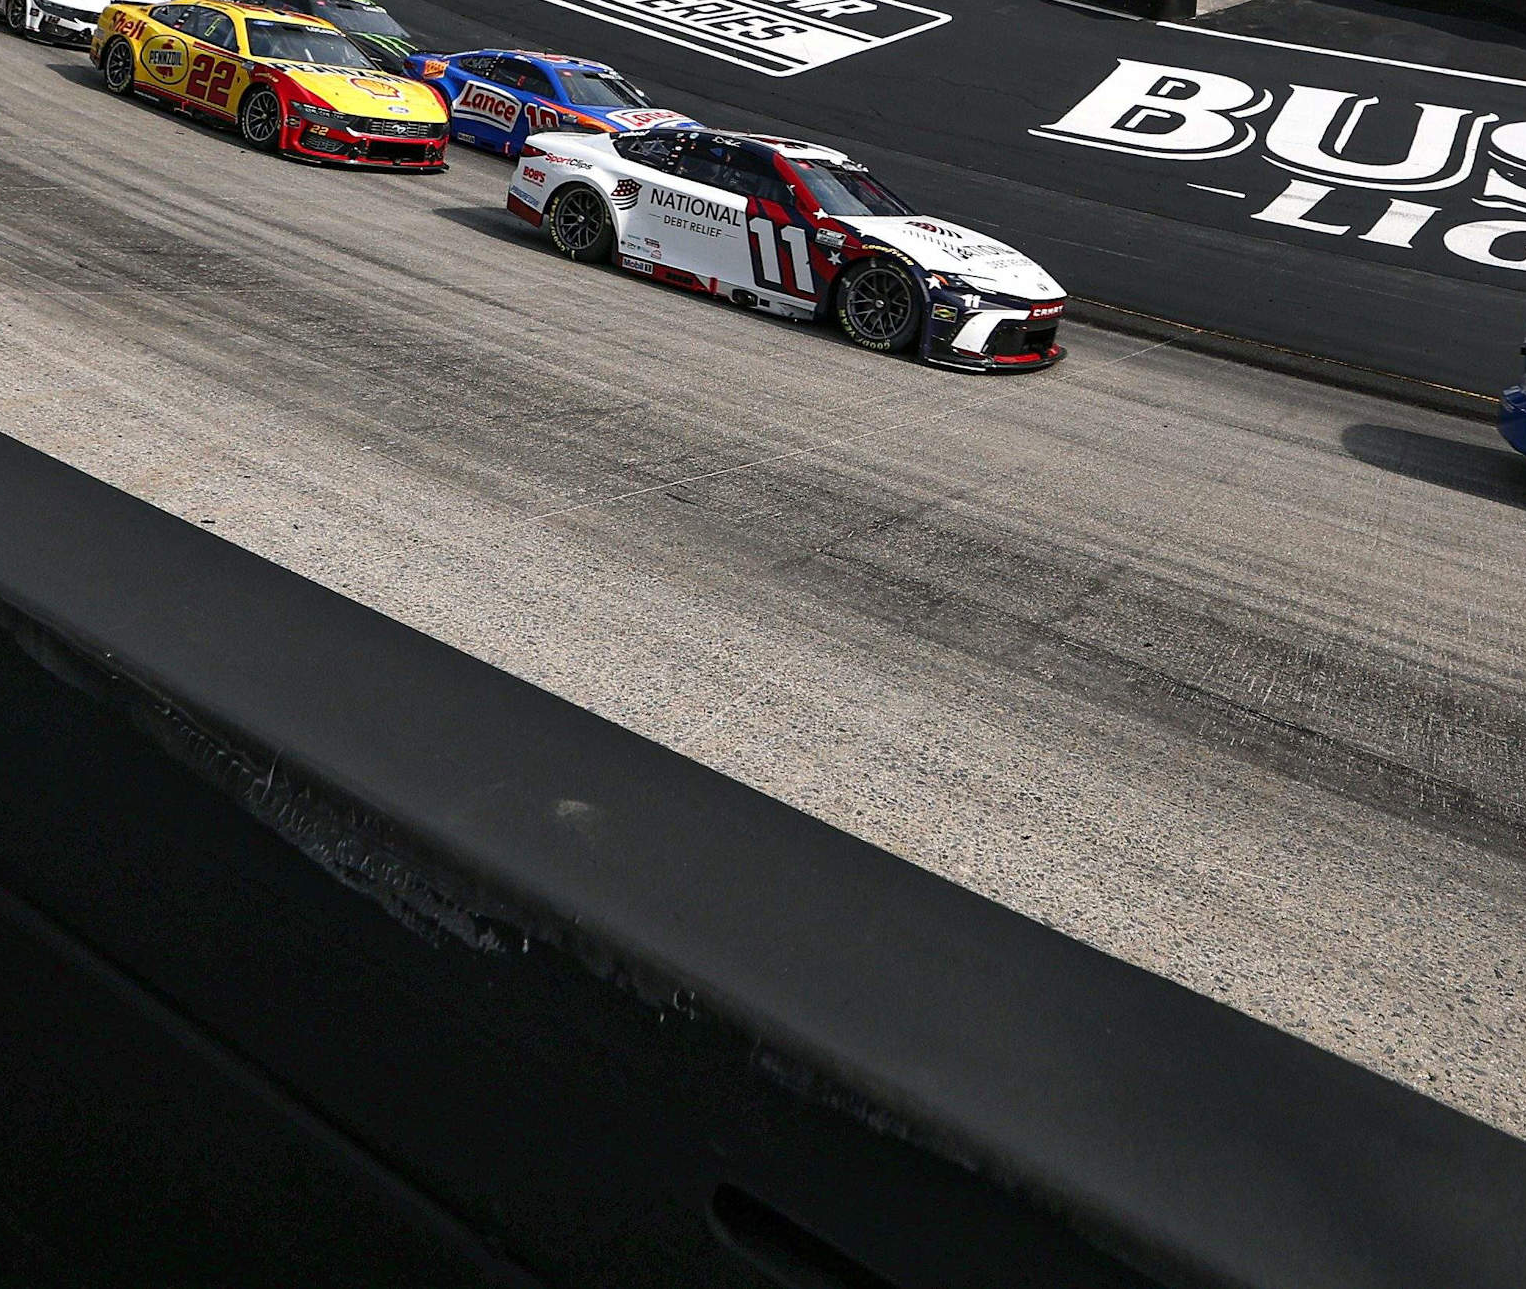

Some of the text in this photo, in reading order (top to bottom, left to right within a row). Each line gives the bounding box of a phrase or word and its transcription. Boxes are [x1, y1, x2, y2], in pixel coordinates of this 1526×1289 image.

[110, 10, 148, 41] Shell
[148, 49, 183, 68] PENNZOIL
[186, 53, 236, 107] 22
[460, 84, 517, 123] Lance
[309, 124, 329, 136] 22
[522, 165, 547, 184] BOB'S
[650, 188, 742, 227] NATIONAL
[663, 214, 723, 238] DEBT RELIEF
[623, 258, 644, 272] Mobil
[748, 213, 815, 296] 11
[961, 293, 982, 309] 11
[1032, 305, 1064, 318] CAMRY
